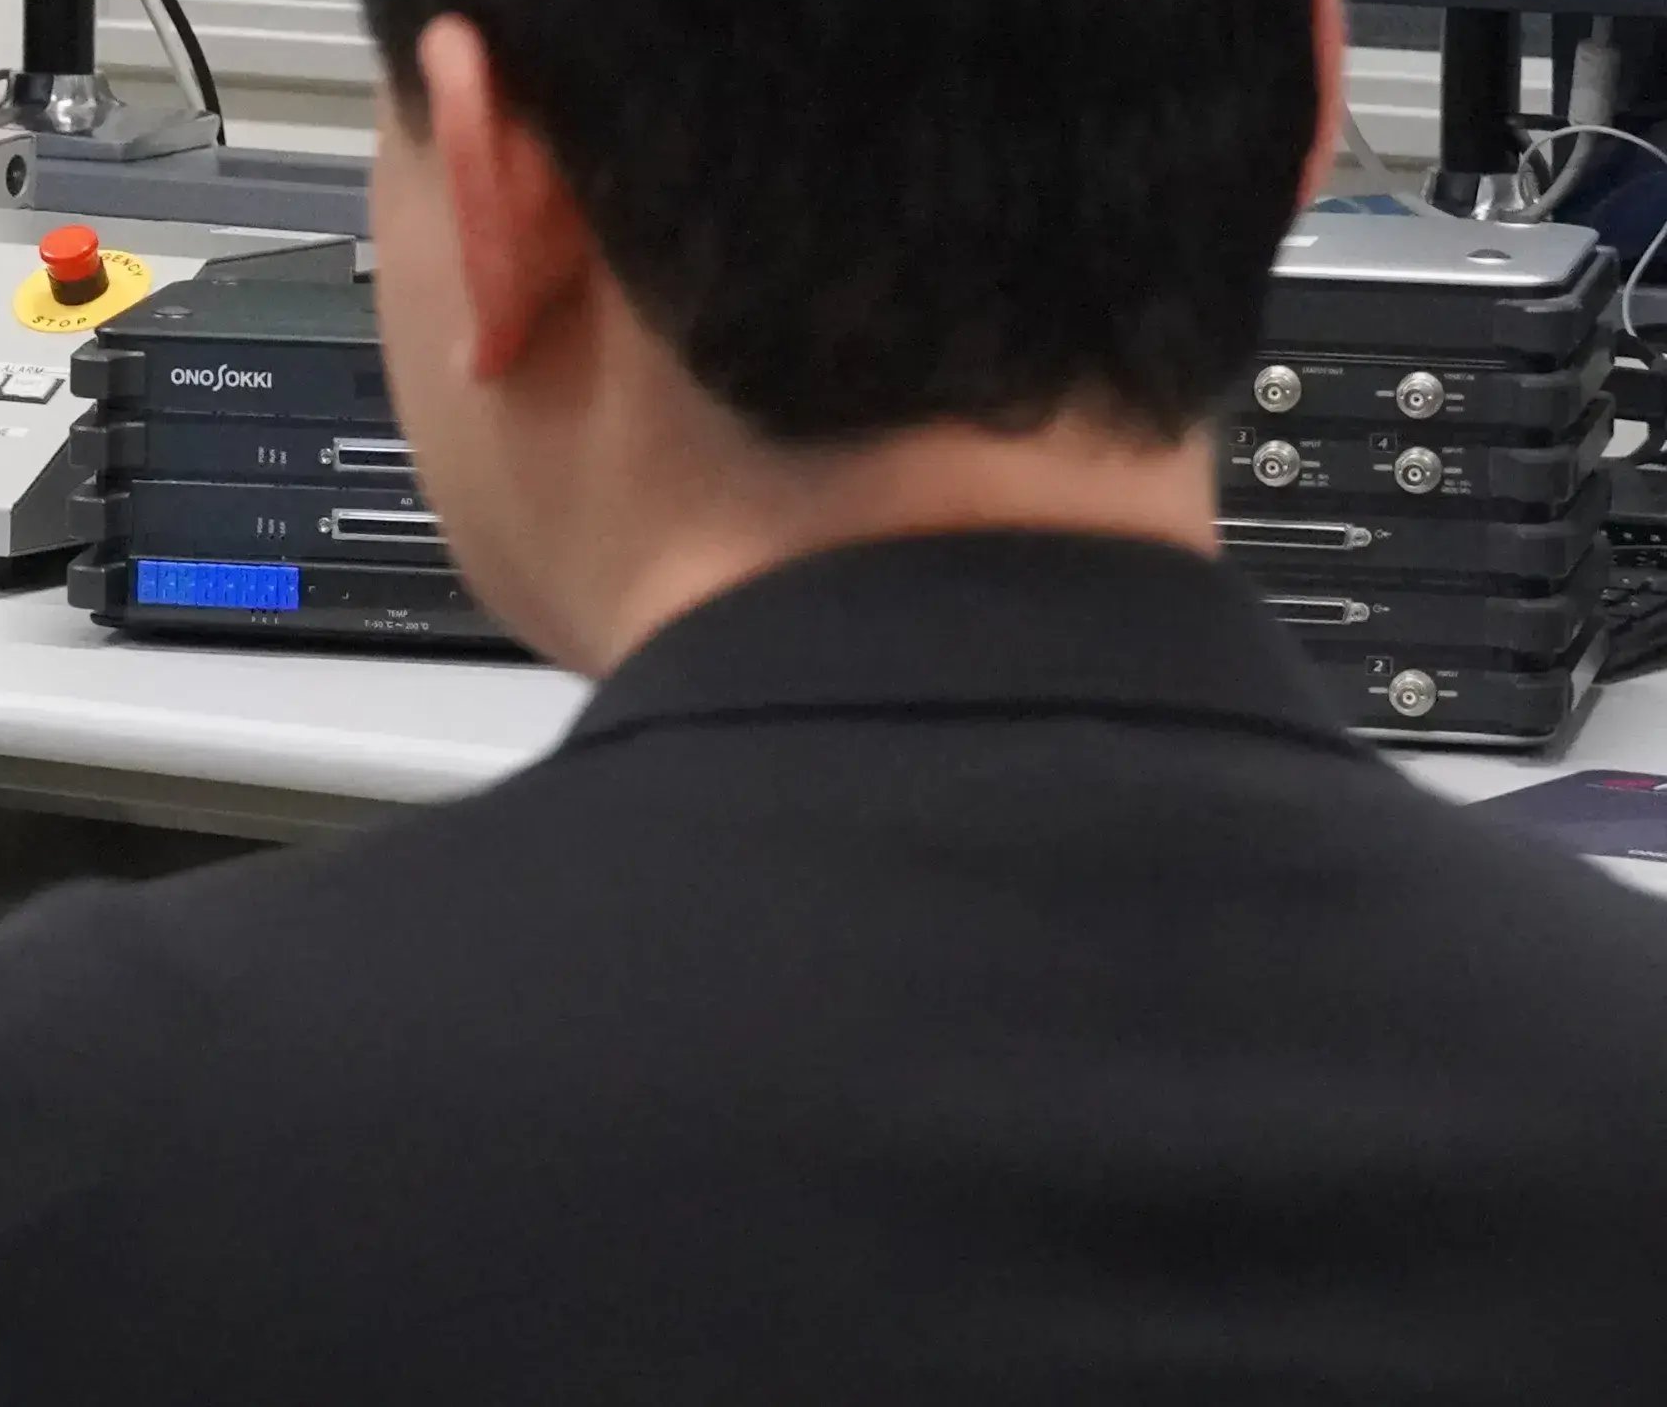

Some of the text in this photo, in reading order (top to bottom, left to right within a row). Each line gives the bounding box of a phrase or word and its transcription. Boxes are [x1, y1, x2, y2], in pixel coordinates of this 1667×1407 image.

[32, 315, 88, 329] STOP
[2, 364, 45, 375] ALARM
[1236, 431, 1247, 443] 3
[386, 609, 409, 618] TEMP
[1373, 660, 1384, 673] 2
